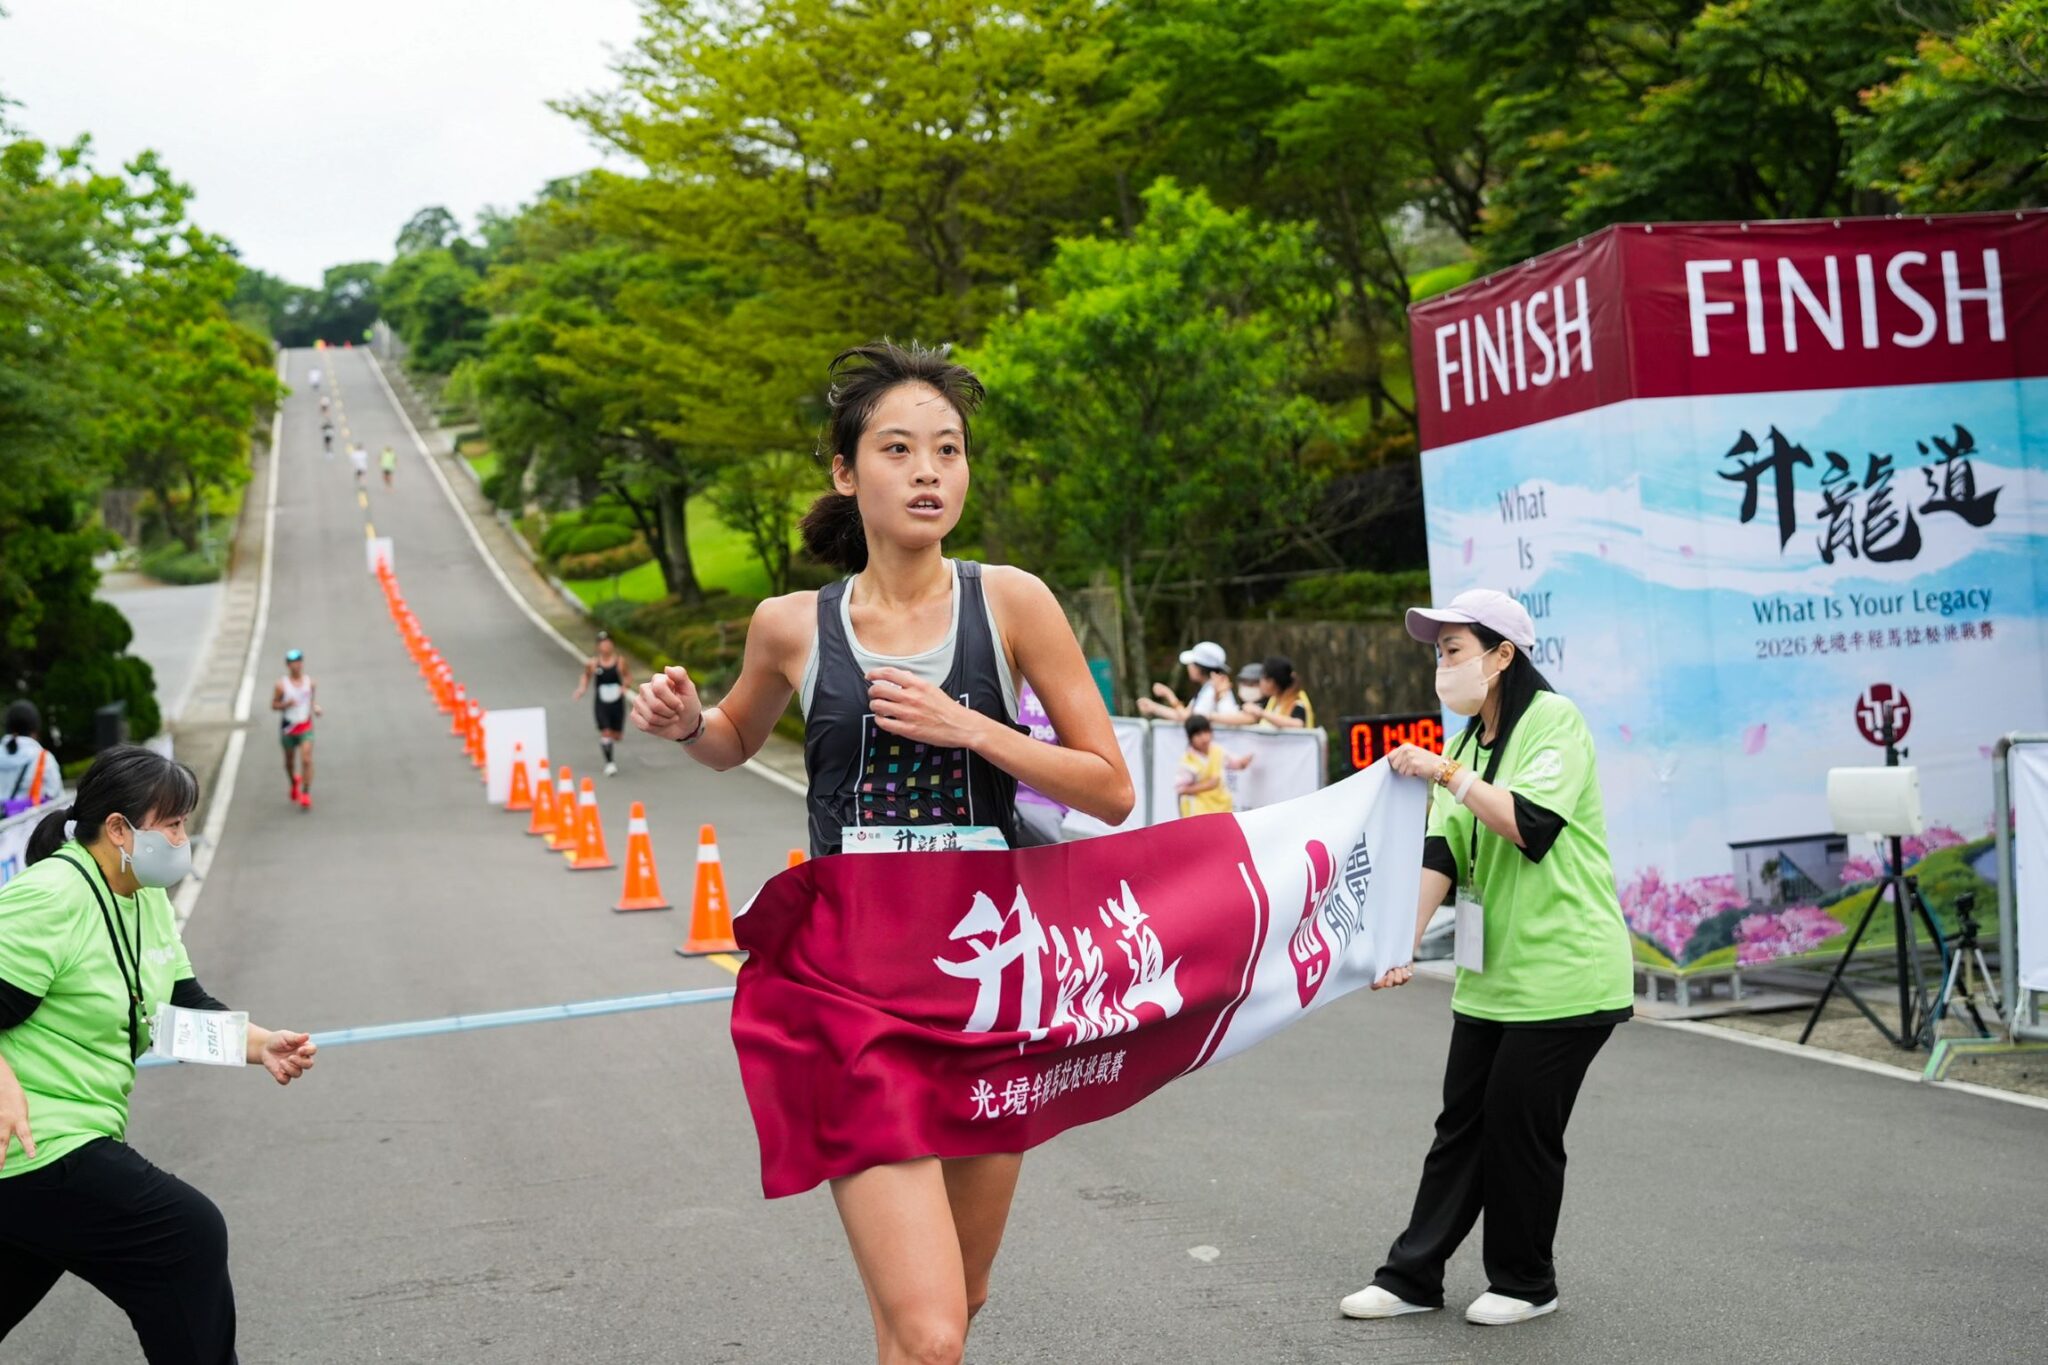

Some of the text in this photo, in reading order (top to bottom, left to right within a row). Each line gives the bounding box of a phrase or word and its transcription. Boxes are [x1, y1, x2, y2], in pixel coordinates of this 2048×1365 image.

[1685, 248, 2006, 357] FINISH
[1434, 276, 1594, 413] FINISH
[1498, 484, 1547, 525] What
[1717, 423, 2005, 565] 升龍道
[1518, 536, 1534, 570] Is
[1753, 588, 1993, 624] What Is Your Legacy
[933, 879, 1184, 1055] 升龍道
[206, 1018, 220, 1056] STAFF
